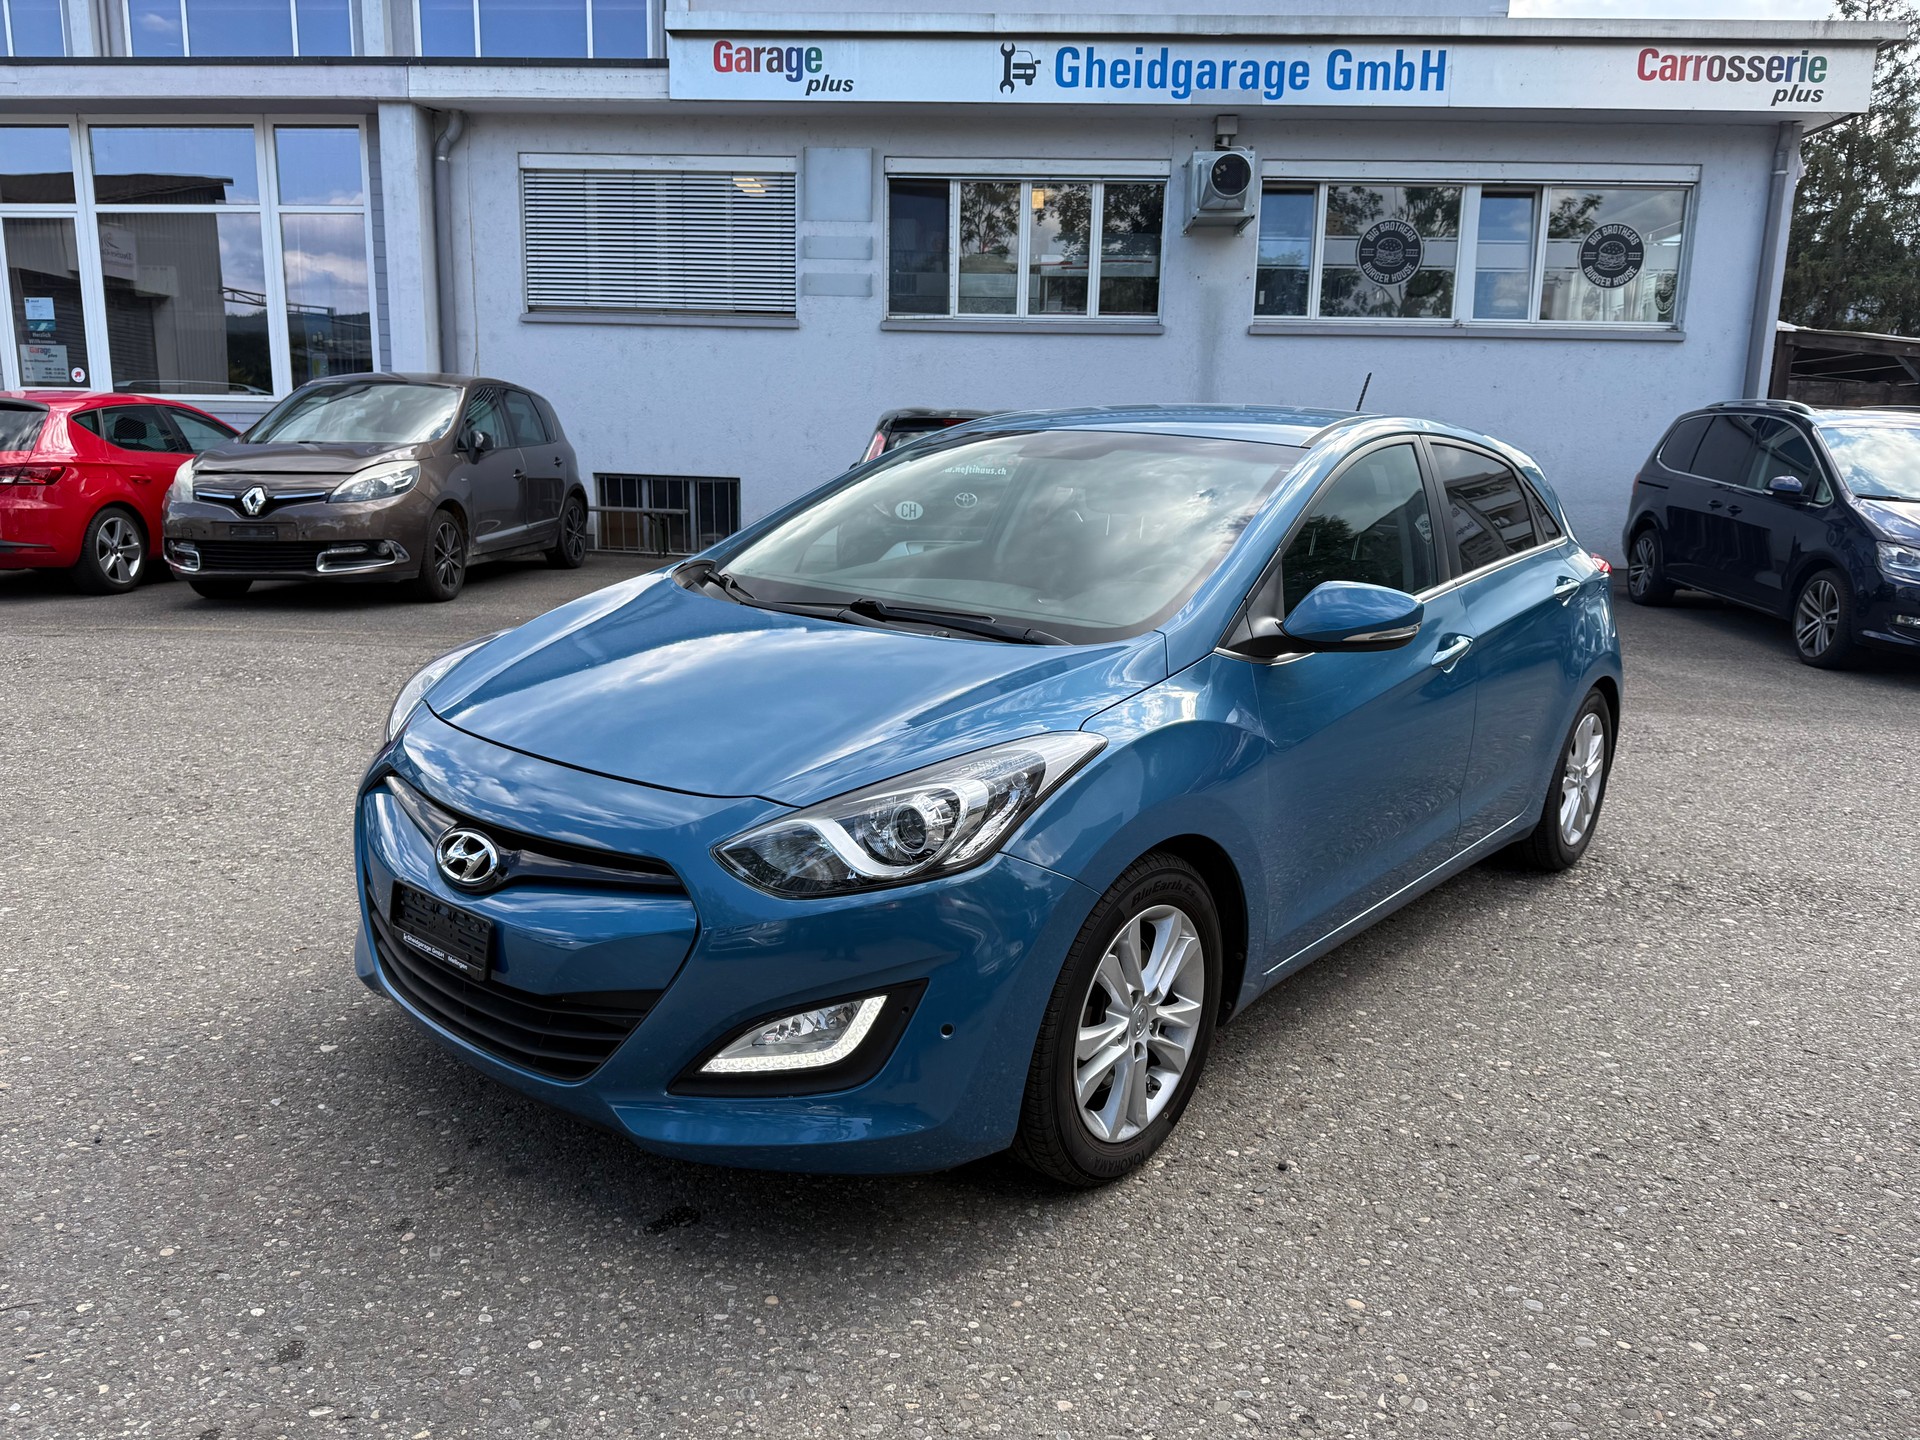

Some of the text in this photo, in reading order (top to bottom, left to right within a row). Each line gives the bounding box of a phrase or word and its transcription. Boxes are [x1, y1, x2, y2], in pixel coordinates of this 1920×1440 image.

[713, 40, 822, 82] Garage
[1637, 48, 1828, 83] Carrosserie
[1054, 46, 1447, 100] Gheidgarage GmbH
[805, 74, 854, 96] plus
[1770, 84, 1824, 106] plus
[1365, 221, 1417, 242] BIG BROTHERS
[1588, 225, 1640, 246] BIG BROTHERS
[1362, 261, 1415, 284] BURGER HOUSE
[1584, 265, 1638, 287] BURGER HOUSE
[29, 346, 51, 355] Garage
[901, 503, 917, 518] CH
[1131, 880, 1183, 908] BluEarth
[1094, 1148, 1147, 1173] YOKOHAMA
